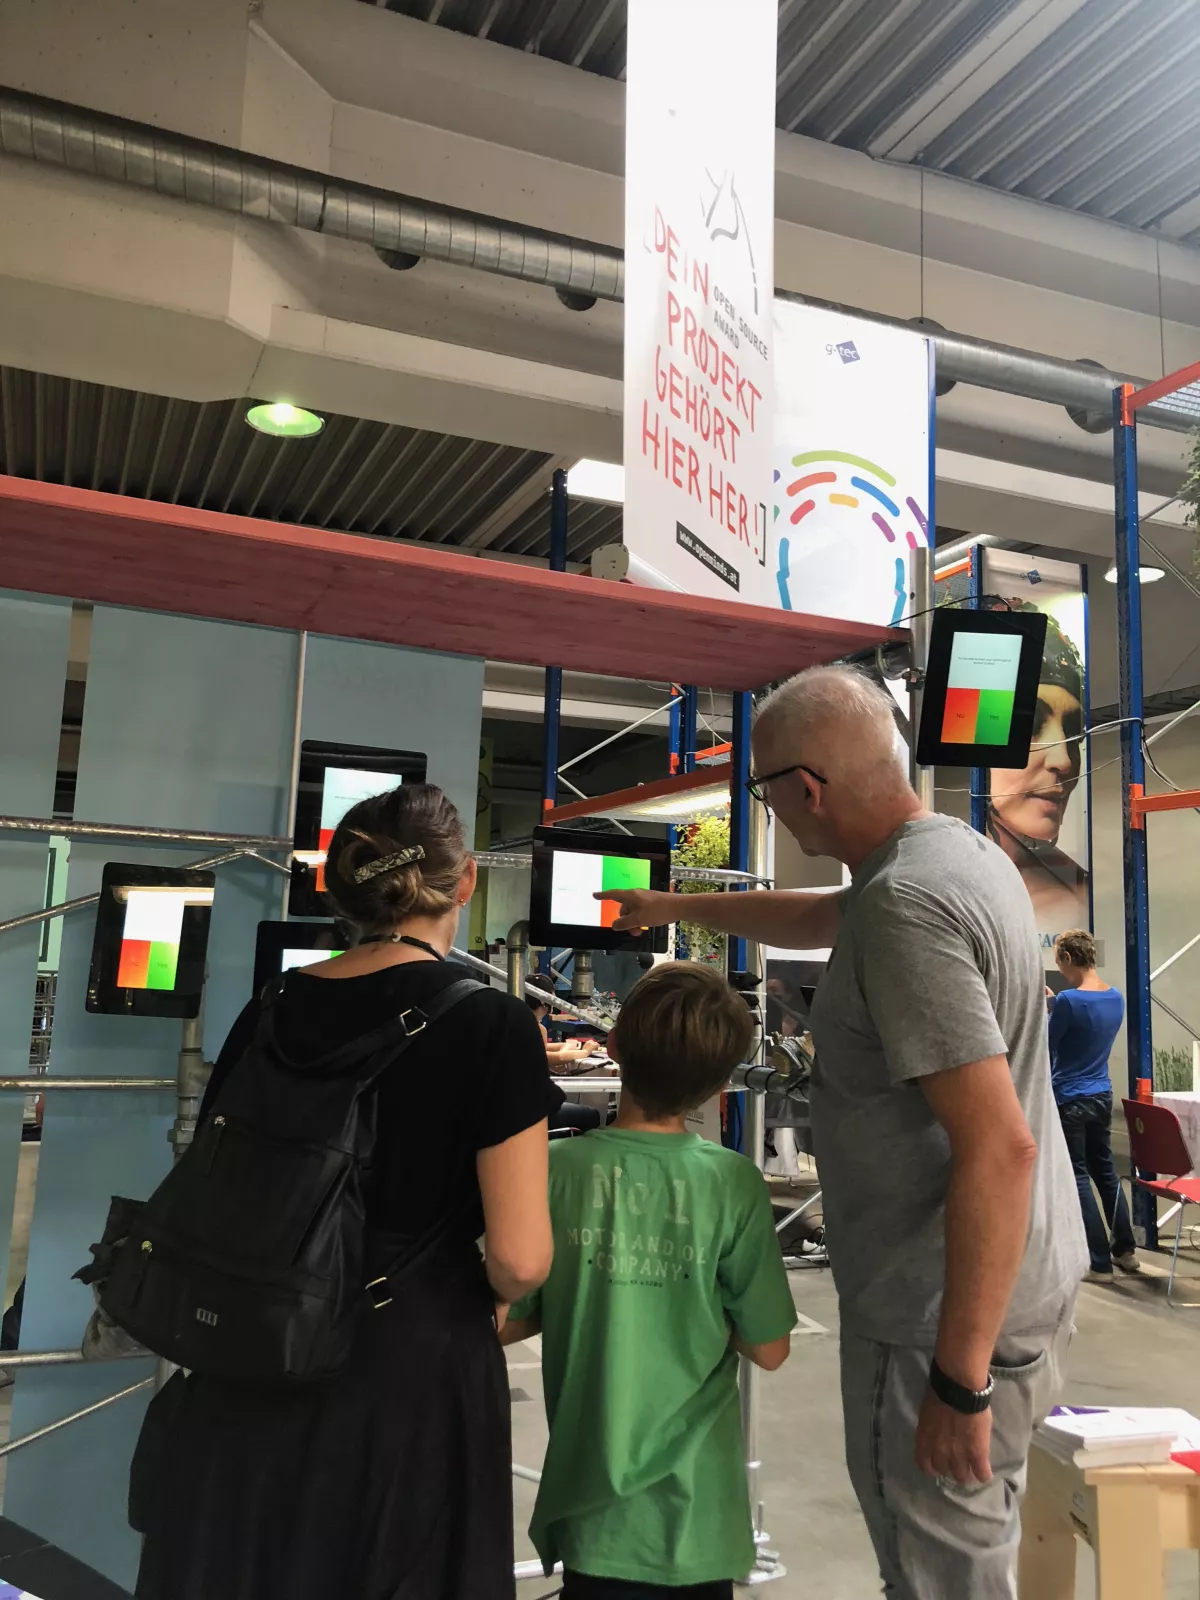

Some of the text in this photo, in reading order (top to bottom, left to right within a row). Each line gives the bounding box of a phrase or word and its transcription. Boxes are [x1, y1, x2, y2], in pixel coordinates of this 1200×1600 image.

[667, 290, 762, 433] PROJEKT
[713, 285, 769, 361] OPEN SOURCE
[713, 310, 740, 350] AWARD
[642, 398, 702, 504] HIER
[655, 344, 741, 464] GEHÖRT
